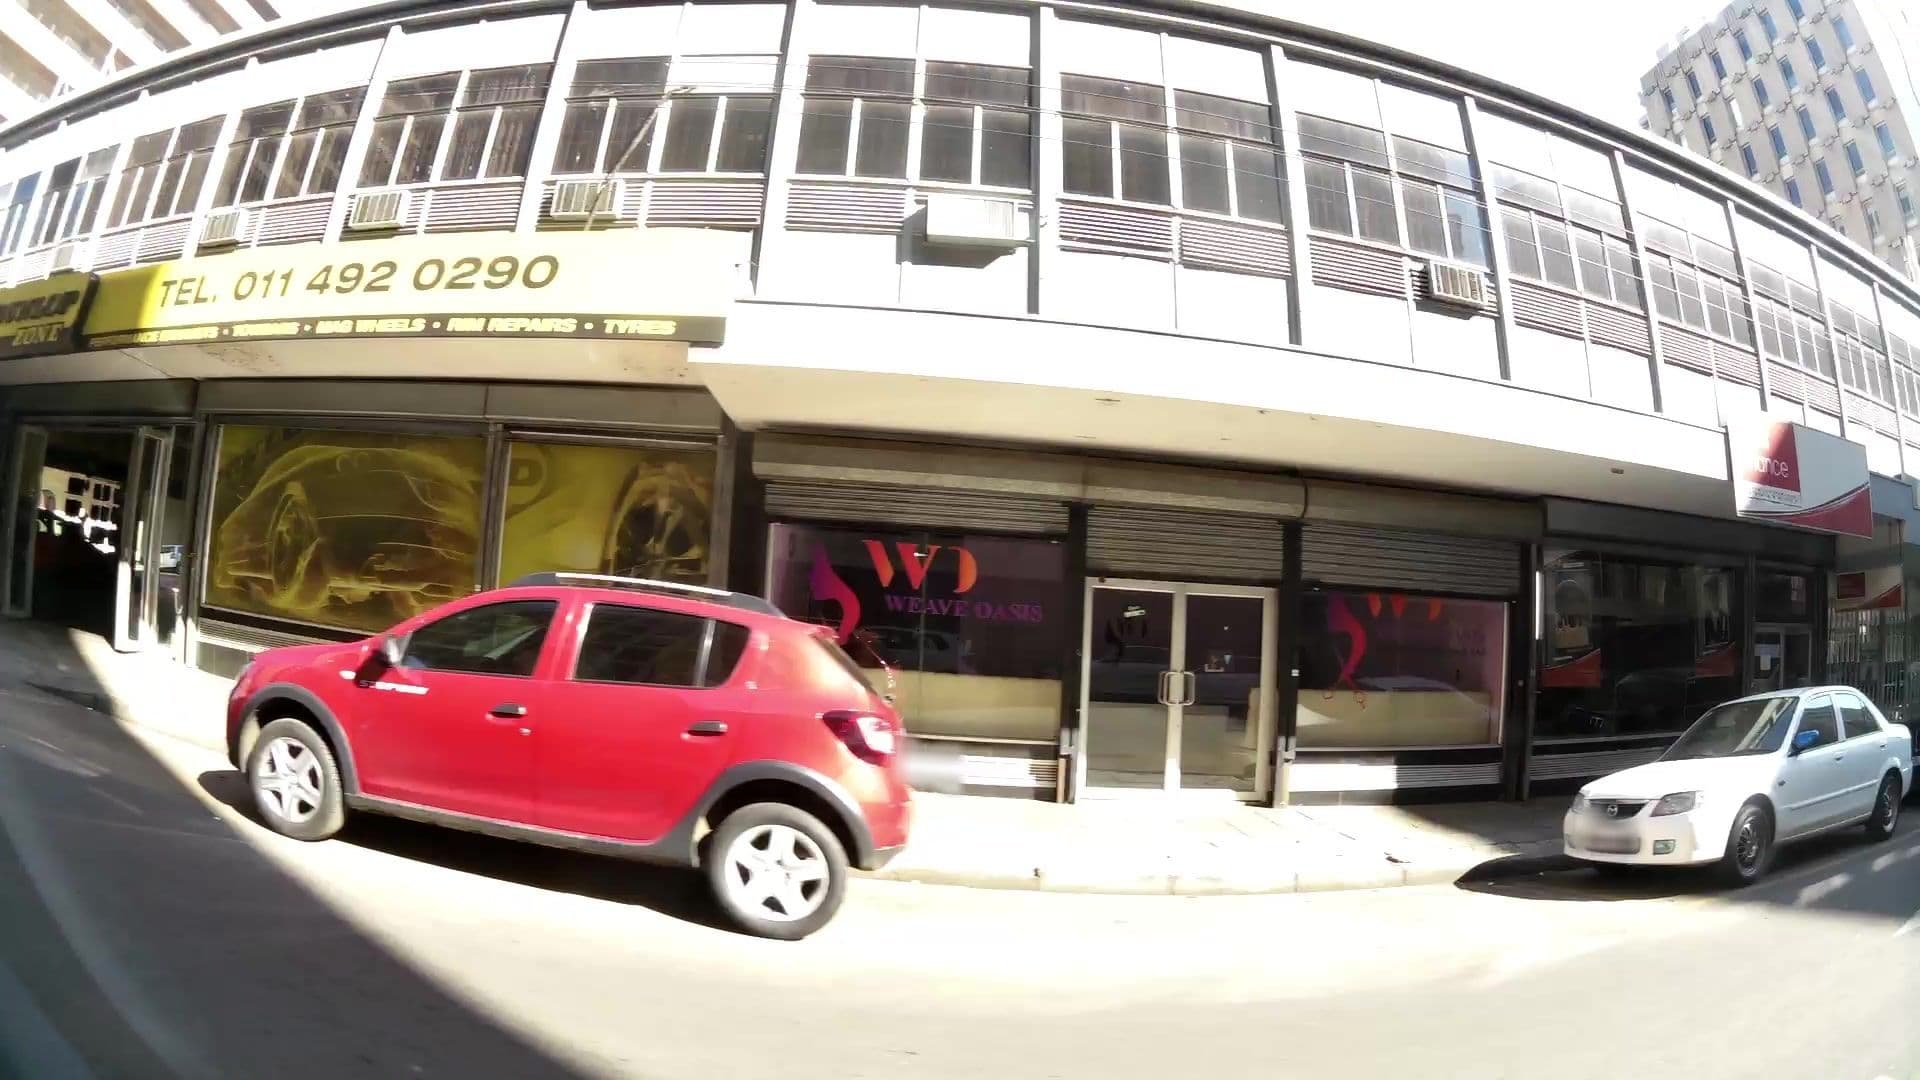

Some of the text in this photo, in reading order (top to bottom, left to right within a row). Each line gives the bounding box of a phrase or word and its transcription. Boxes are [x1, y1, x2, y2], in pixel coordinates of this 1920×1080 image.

[160, 255, 559, 307] TEL. 011 492 0290
[603, 319, 677, 335] TYRES
[885, 593, 1043, 623] WEAVE OASIS
